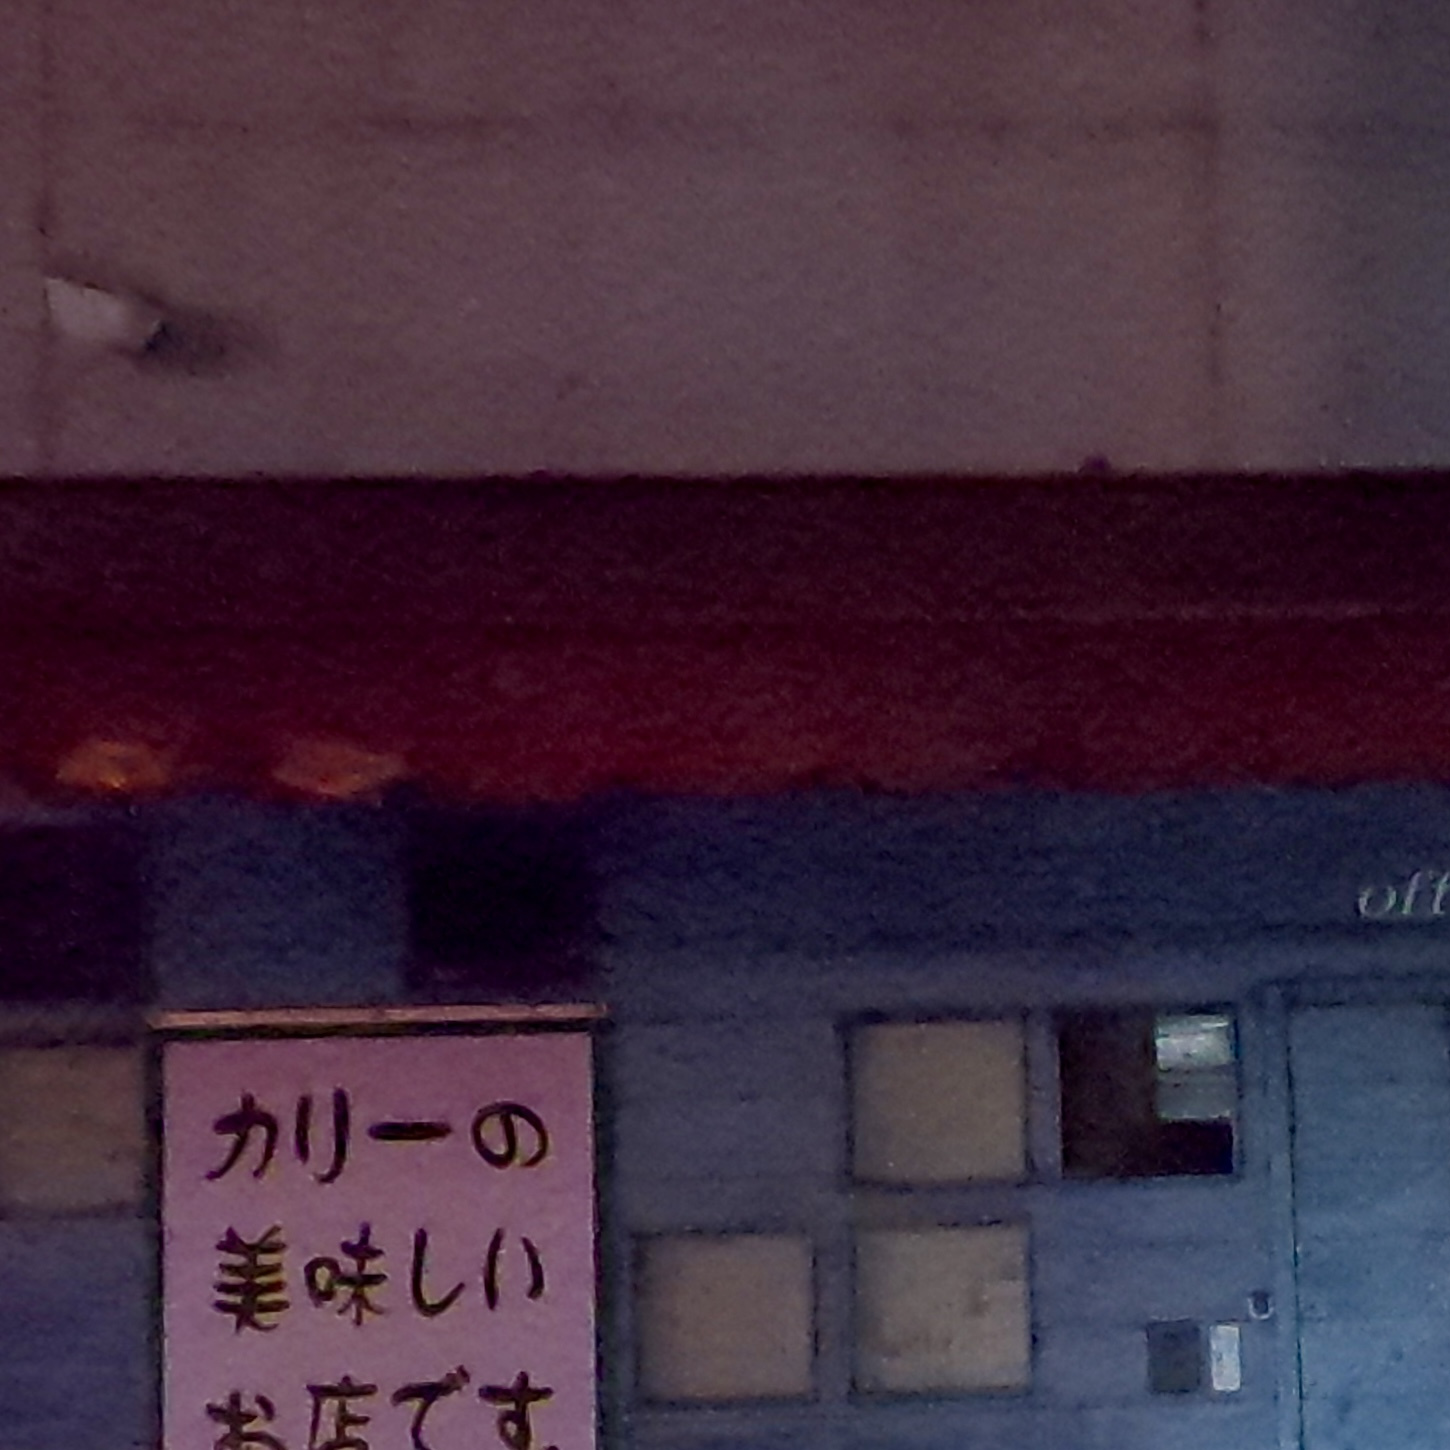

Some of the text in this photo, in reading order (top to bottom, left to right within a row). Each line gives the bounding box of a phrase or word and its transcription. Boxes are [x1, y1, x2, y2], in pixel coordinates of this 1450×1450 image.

[206, 1087, 548, 1184] カリーの
[213, 1221, 545, 1334] 美味しい
